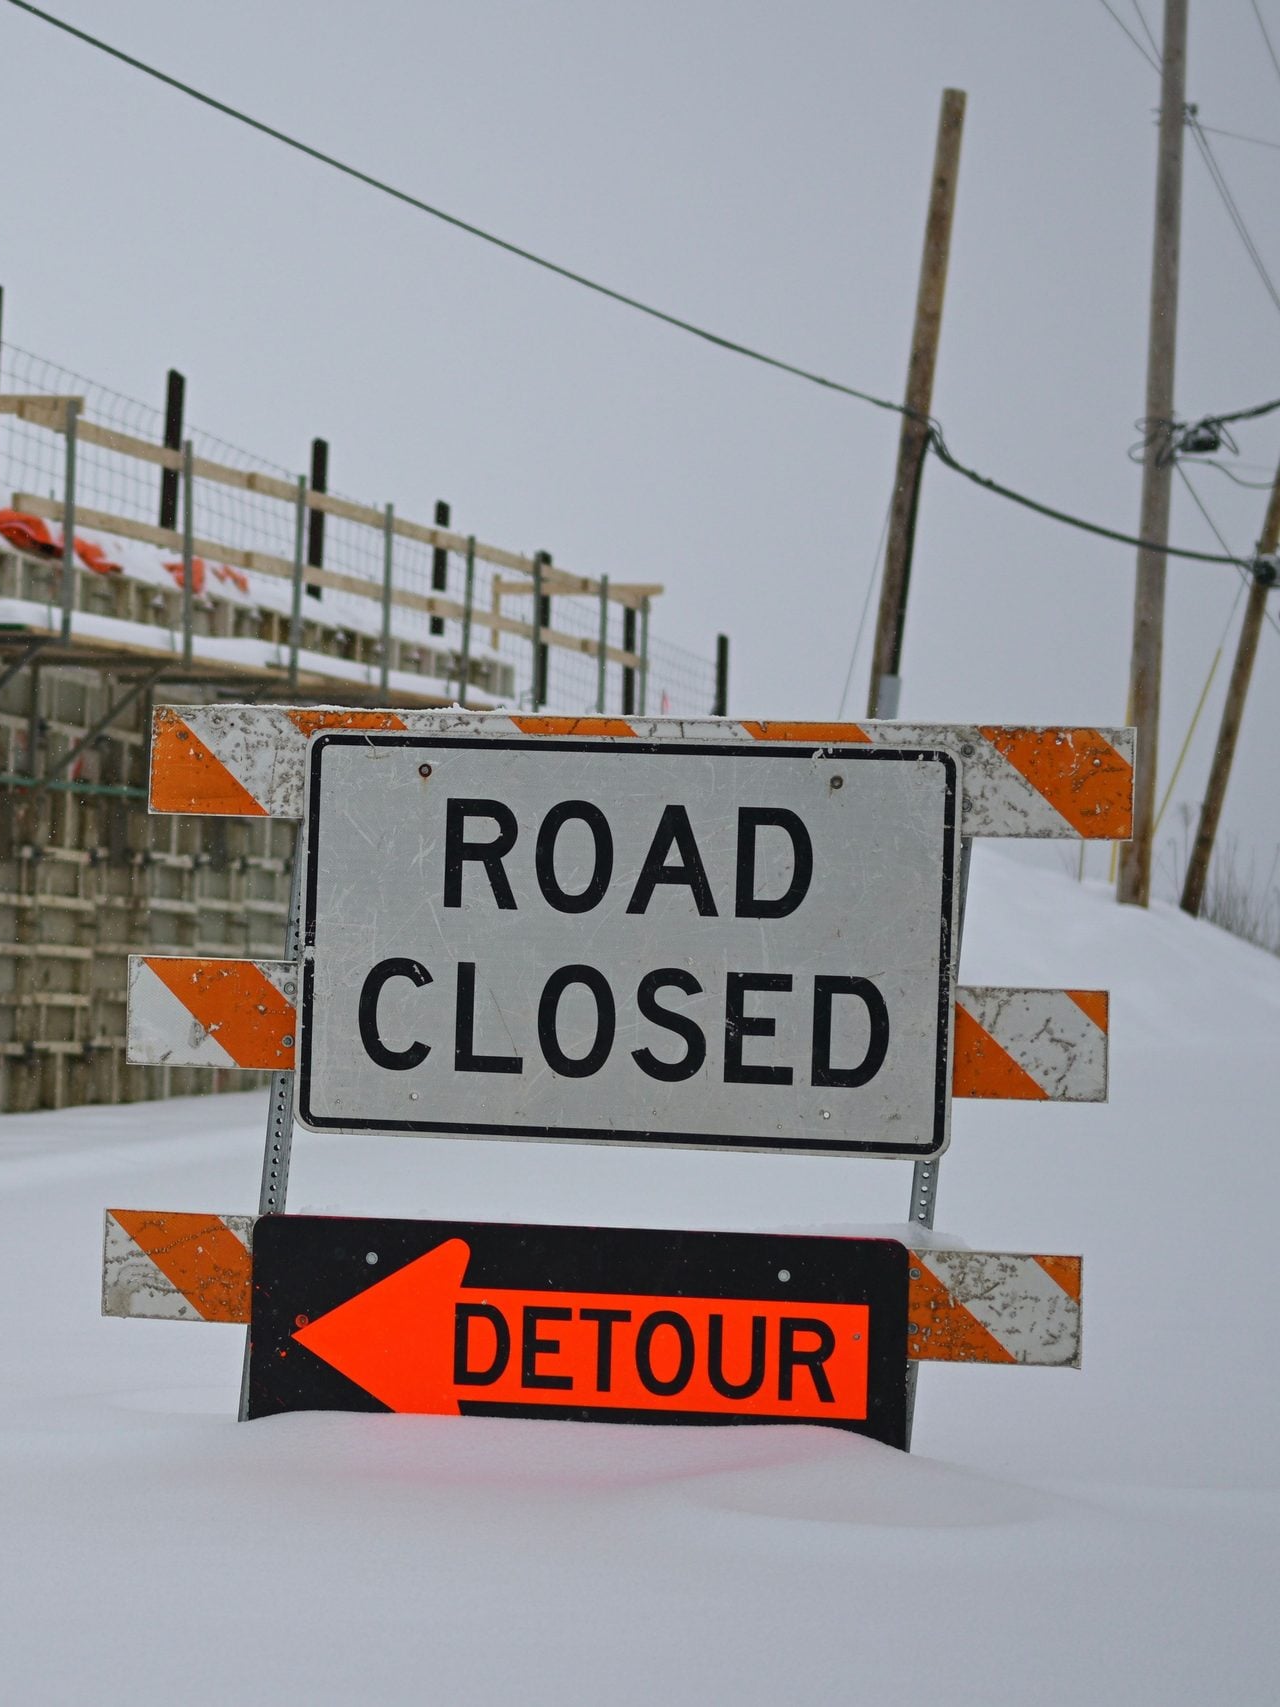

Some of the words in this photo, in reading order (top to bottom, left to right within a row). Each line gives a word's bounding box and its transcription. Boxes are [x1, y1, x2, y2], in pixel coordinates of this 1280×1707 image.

[443, 798, 813, 919] ROAD
[359, 958, 889, 1088] CLOSED
[454, 1303, 835, 1402] DETOUR
